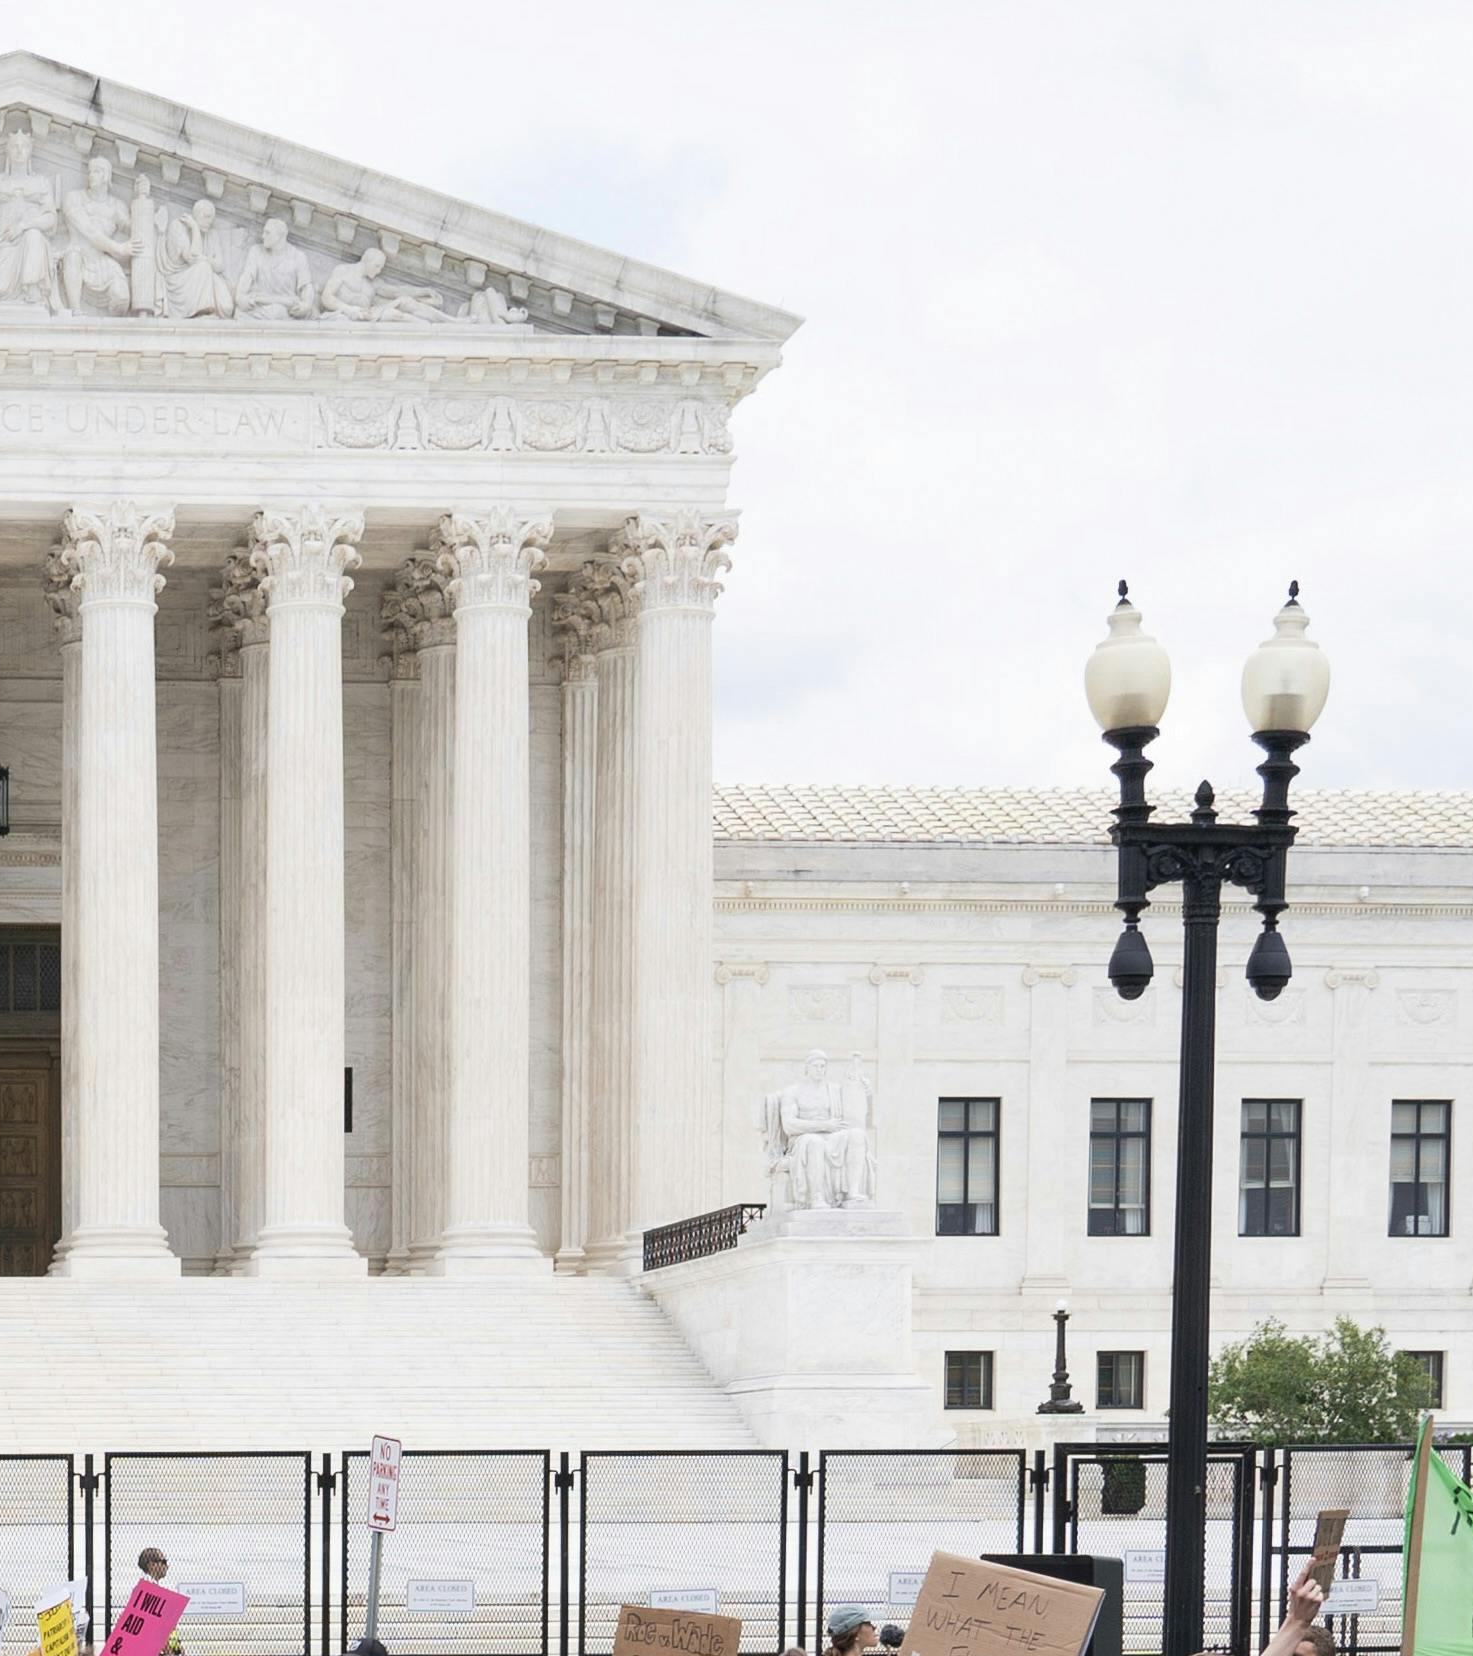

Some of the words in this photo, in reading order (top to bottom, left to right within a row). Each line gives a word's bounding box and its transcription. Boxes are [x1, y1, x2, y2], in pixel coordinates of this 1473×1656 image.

[64, 404, 194, 435] UNDER
[213, 406, 289, 437] LAW
[380, 1443, 392, 1460] NO
[373, 1461, 397, 1481] PARKING
[377, 1482, 390, 1495] ANY
[375, 1498, 390, 1511] TIME
[942, 1571, 965, 1598] I
[133, 1590, 143, 1608] I
[140, 1594, 167, 1618] WILL
[121, 1613, 145, 1636] AID
[624, 1612, 656, 1645] Roe
[671, 1618, 725, 1656] Wade
[926, 1608, 992, 1641] WHAT
[1005, 1625, 1046, 1652] THE
[110, 1636, 123, 1656] &
